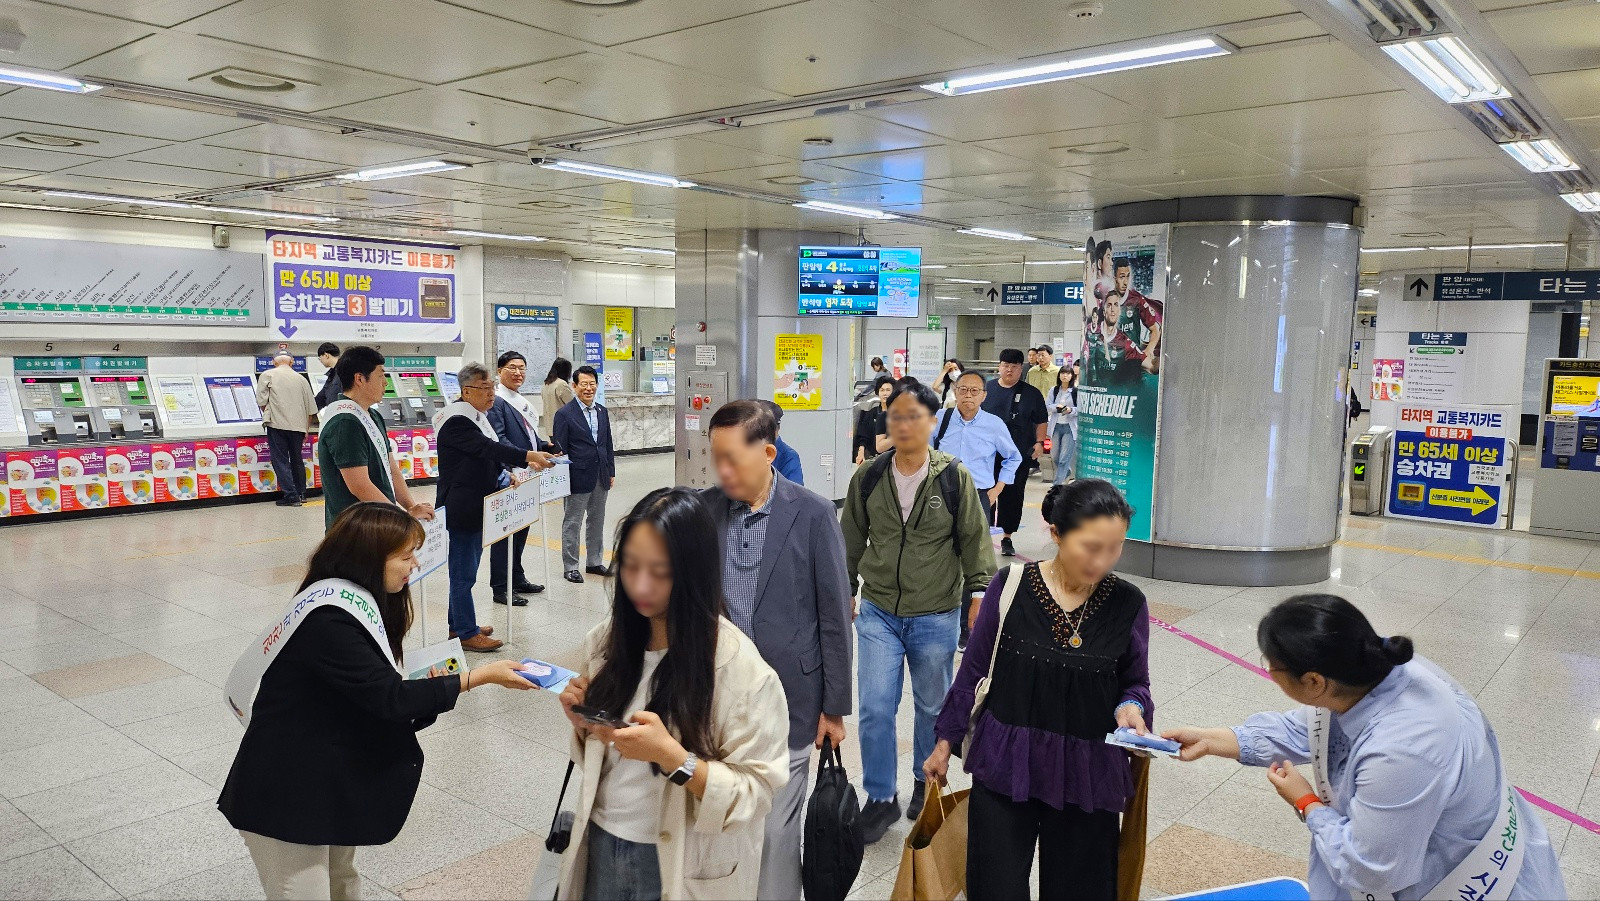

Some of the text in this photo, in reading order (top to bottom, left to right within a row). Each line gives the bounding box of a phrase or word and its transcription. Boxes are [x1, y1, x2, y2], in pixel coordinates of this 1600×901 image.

[273, 240, 455, 269] 타지역 교통복지카드 이용불가
[802, 262, 822, 272] 판암행
[826, 261, 838, 272] 4
[280, 269, 372, 292] 만 65세 이상
[1539, 276, 1587, 294] 타는
[279, 293, 413, 317] 승차권은 3 발매기
[510, 308, 540, 316] 대전도시철도
[825, 298, 838, 308] 열차
[840, 298, 853, 308] 도착
[1421, 332, 1440, 340] 타는
[45, 342, 53, 351] 5
[112, 343, 120, 352] 4
[1088, 392, 1138, 419] SCHEDULE
[1401, 408, 1502, 428] 타지역 교통복지카드
[1430, 429, 1468, 440] 이용불가
[1398, 441, 1499, 464] 만 65세 이상
[1396, 458, 1451, 480] 승차권
